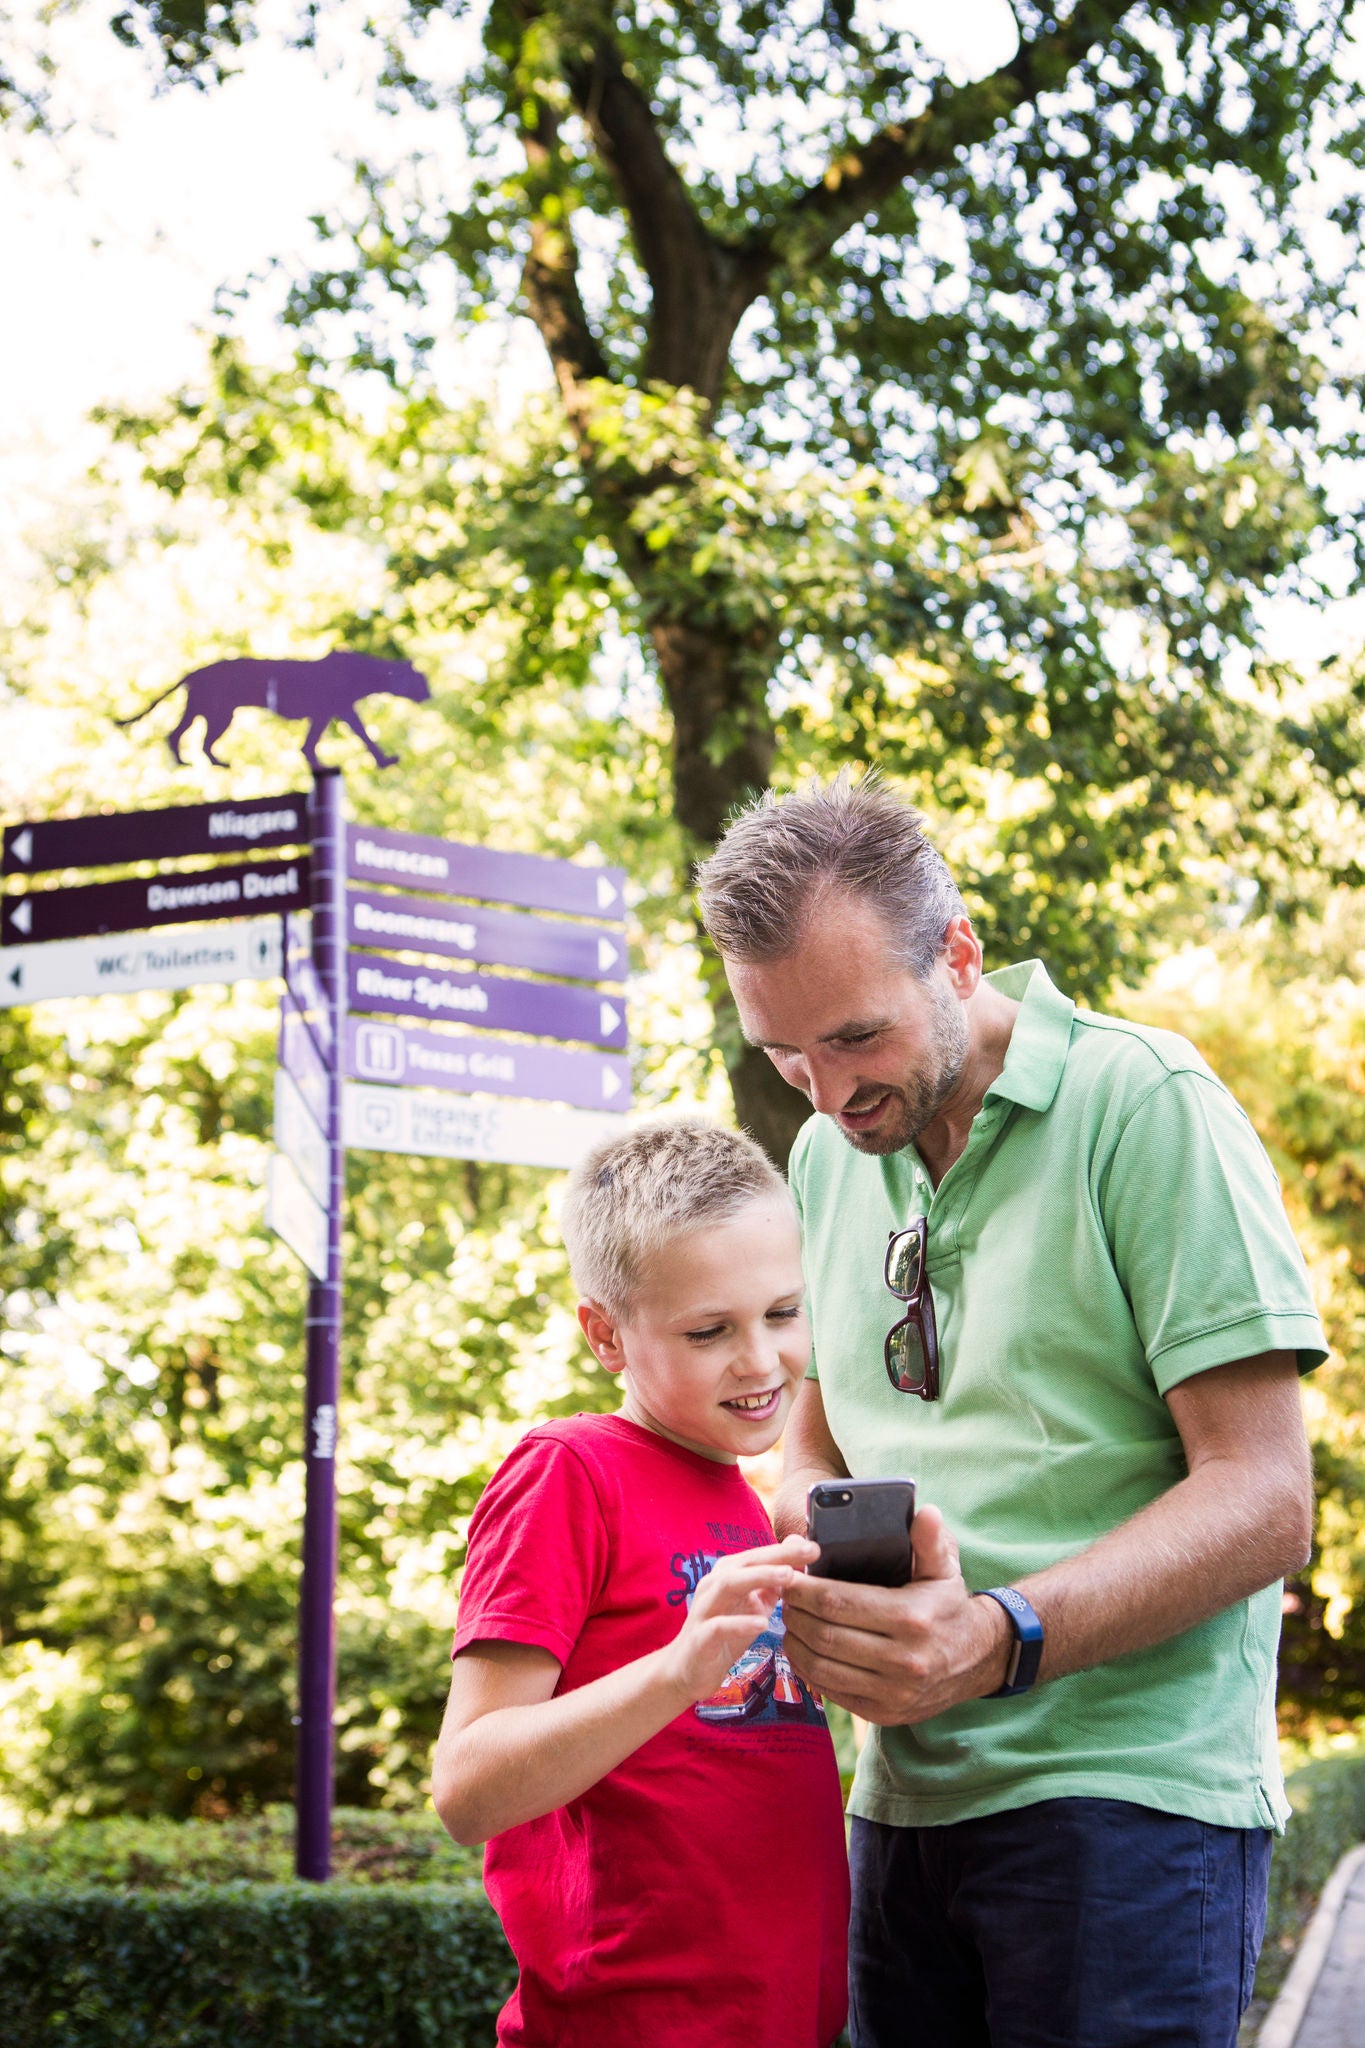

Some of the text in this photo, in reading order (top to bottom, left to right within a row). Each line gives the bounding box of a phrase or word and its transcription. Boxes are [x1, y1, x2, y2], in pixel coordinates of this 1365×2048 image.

[209, 809, 297, 839] Niagara
[355, 838, 449, 878] Huracan
[147, 867, 299, 911] Dawson Duel
[354, 902, 476, 950] Boomerang
[356, 967, 488, 1012] River Splash
[407, 1043, 516, 1081] Texas Grill
[706, 1521, 725, 1541] THE
